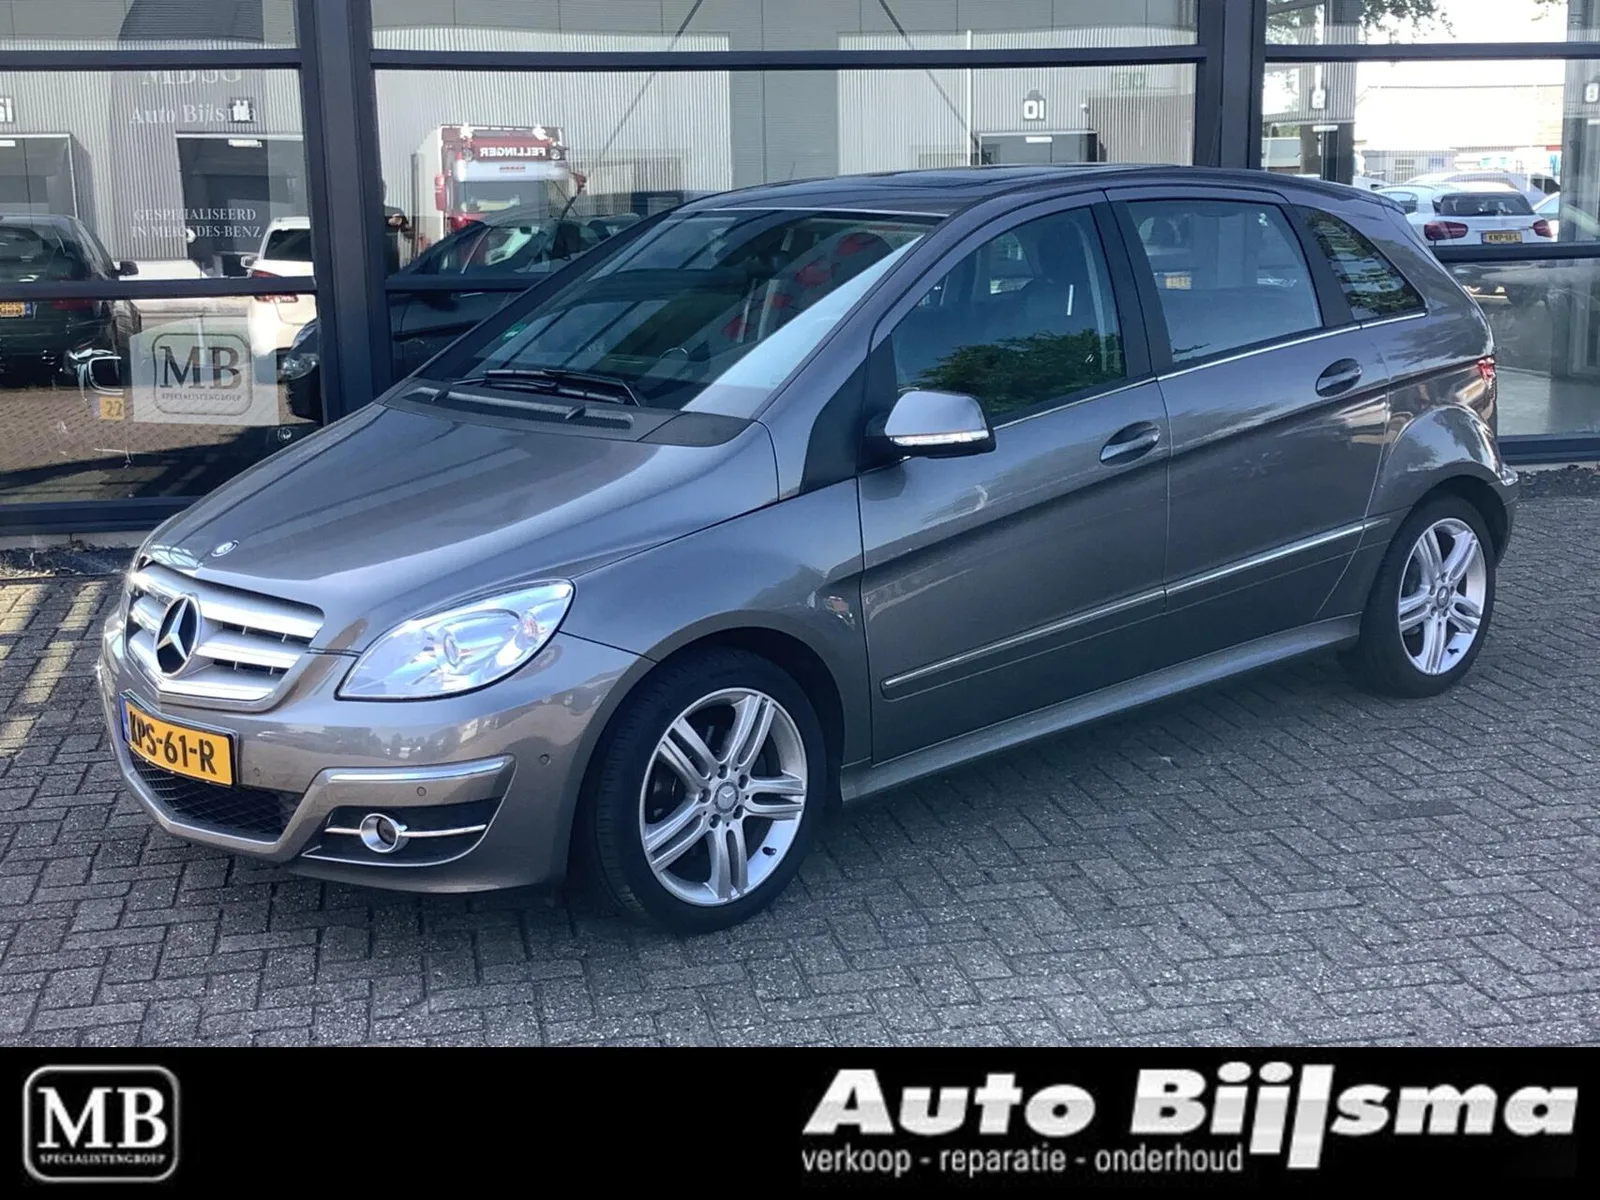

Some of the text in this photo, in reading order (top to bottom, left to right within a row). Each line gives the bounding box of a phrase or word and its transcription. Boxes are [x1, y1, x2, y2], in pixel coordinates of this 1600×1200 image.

[130, 106, 176, 123] Auto
[159, 345, 242, 389] MB
[129, 711, 217, 775] KPS-61-R
